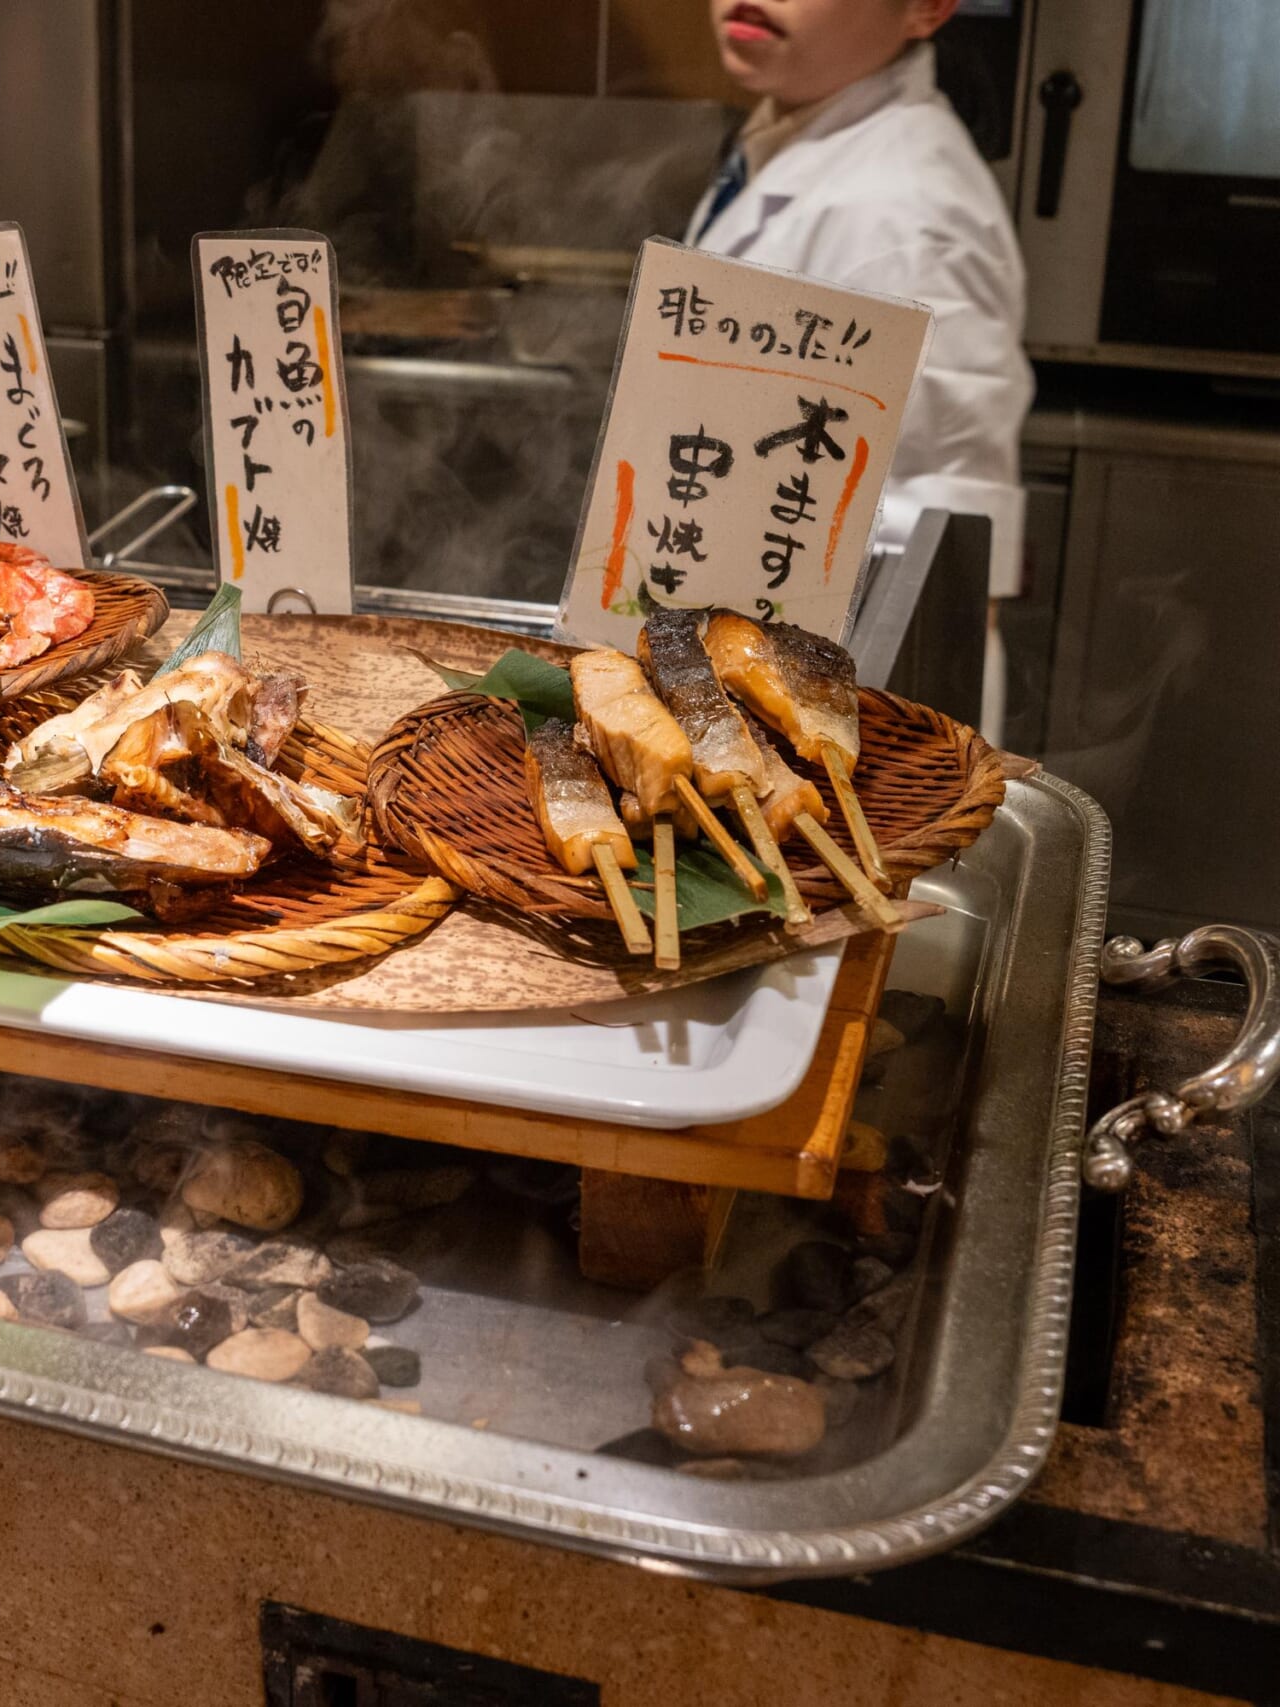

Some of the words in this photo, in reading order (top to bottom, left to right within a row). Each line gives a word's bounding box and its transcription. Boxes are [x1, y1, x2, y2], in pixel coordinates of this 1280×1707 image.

[0, 332, 51, 502] まぐろ
[225, 334, 282, 553] カブト焼
[276, 275, 324, 447] 旬魚の
[753, 395, 849, 622] 本ますの
